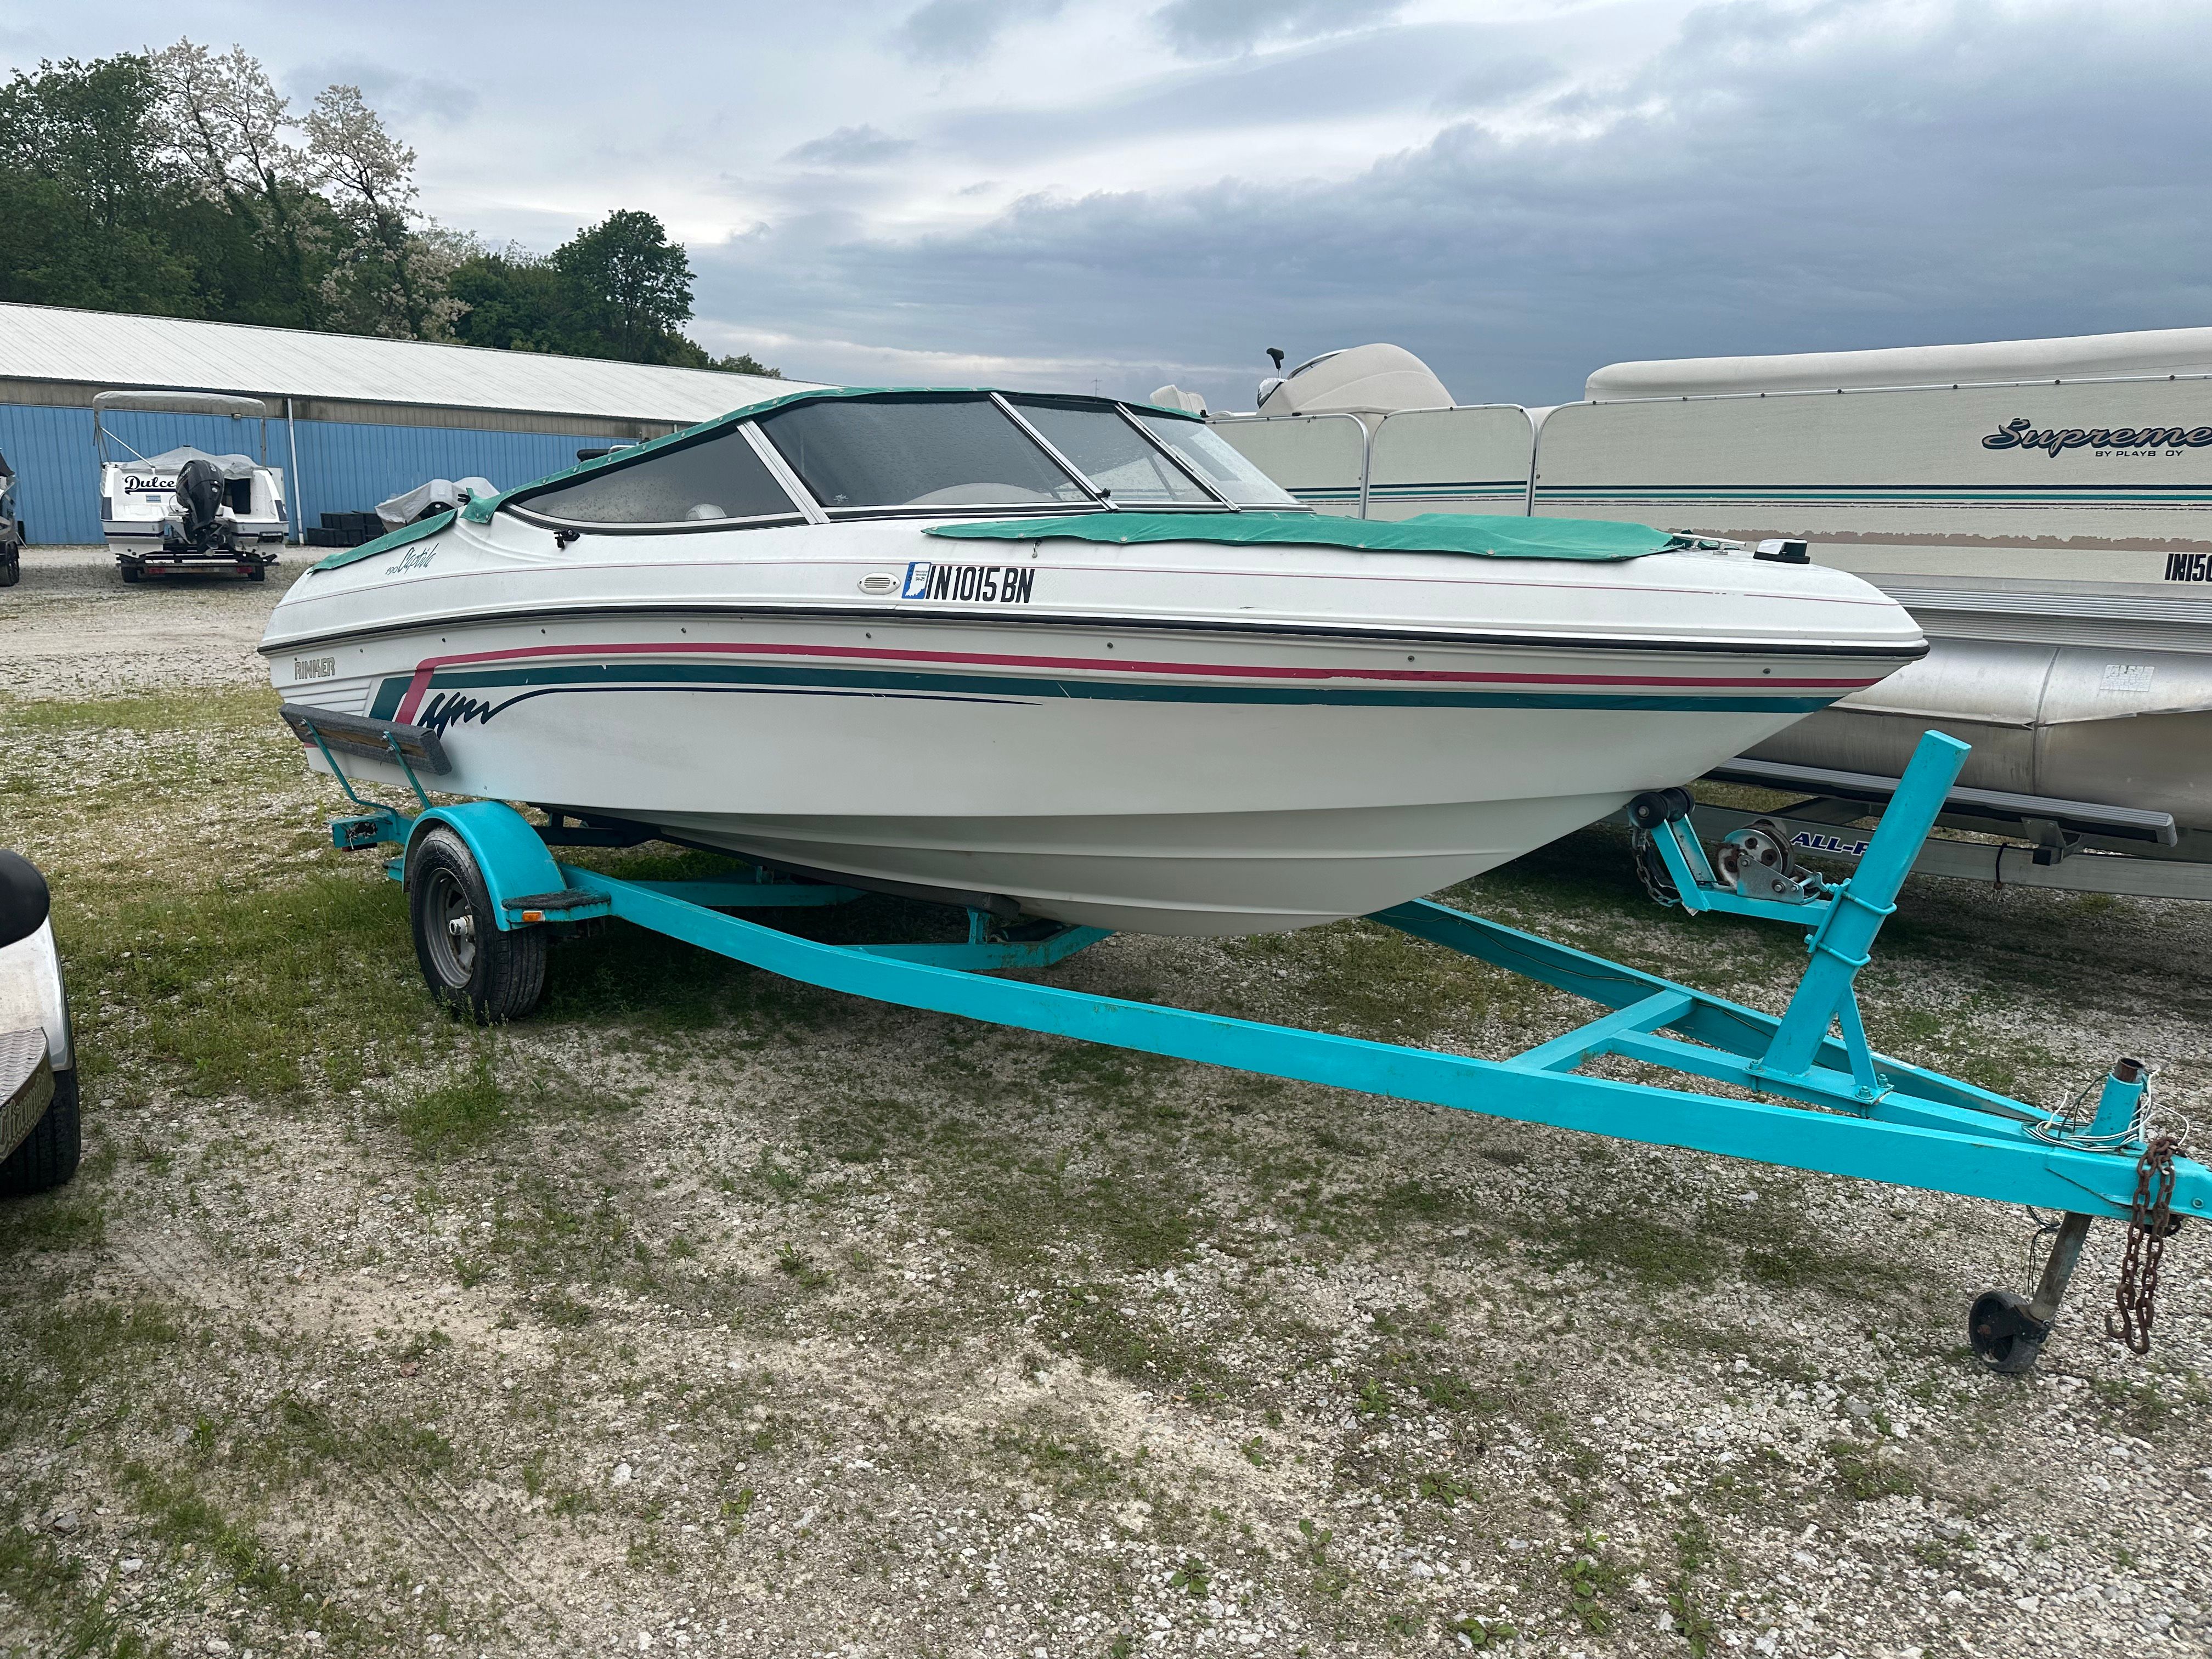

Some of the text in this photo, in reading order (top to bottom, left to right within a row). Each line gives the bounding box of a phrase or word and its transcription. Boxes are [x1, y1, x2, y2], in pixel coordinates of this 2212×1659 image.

[1982, 418, 2212, 458] Supreme
[125, 476, 175, 490] Dulce
[1000, 567, 1035, 603] BN
[295, 657, 335, 680] RINKER
